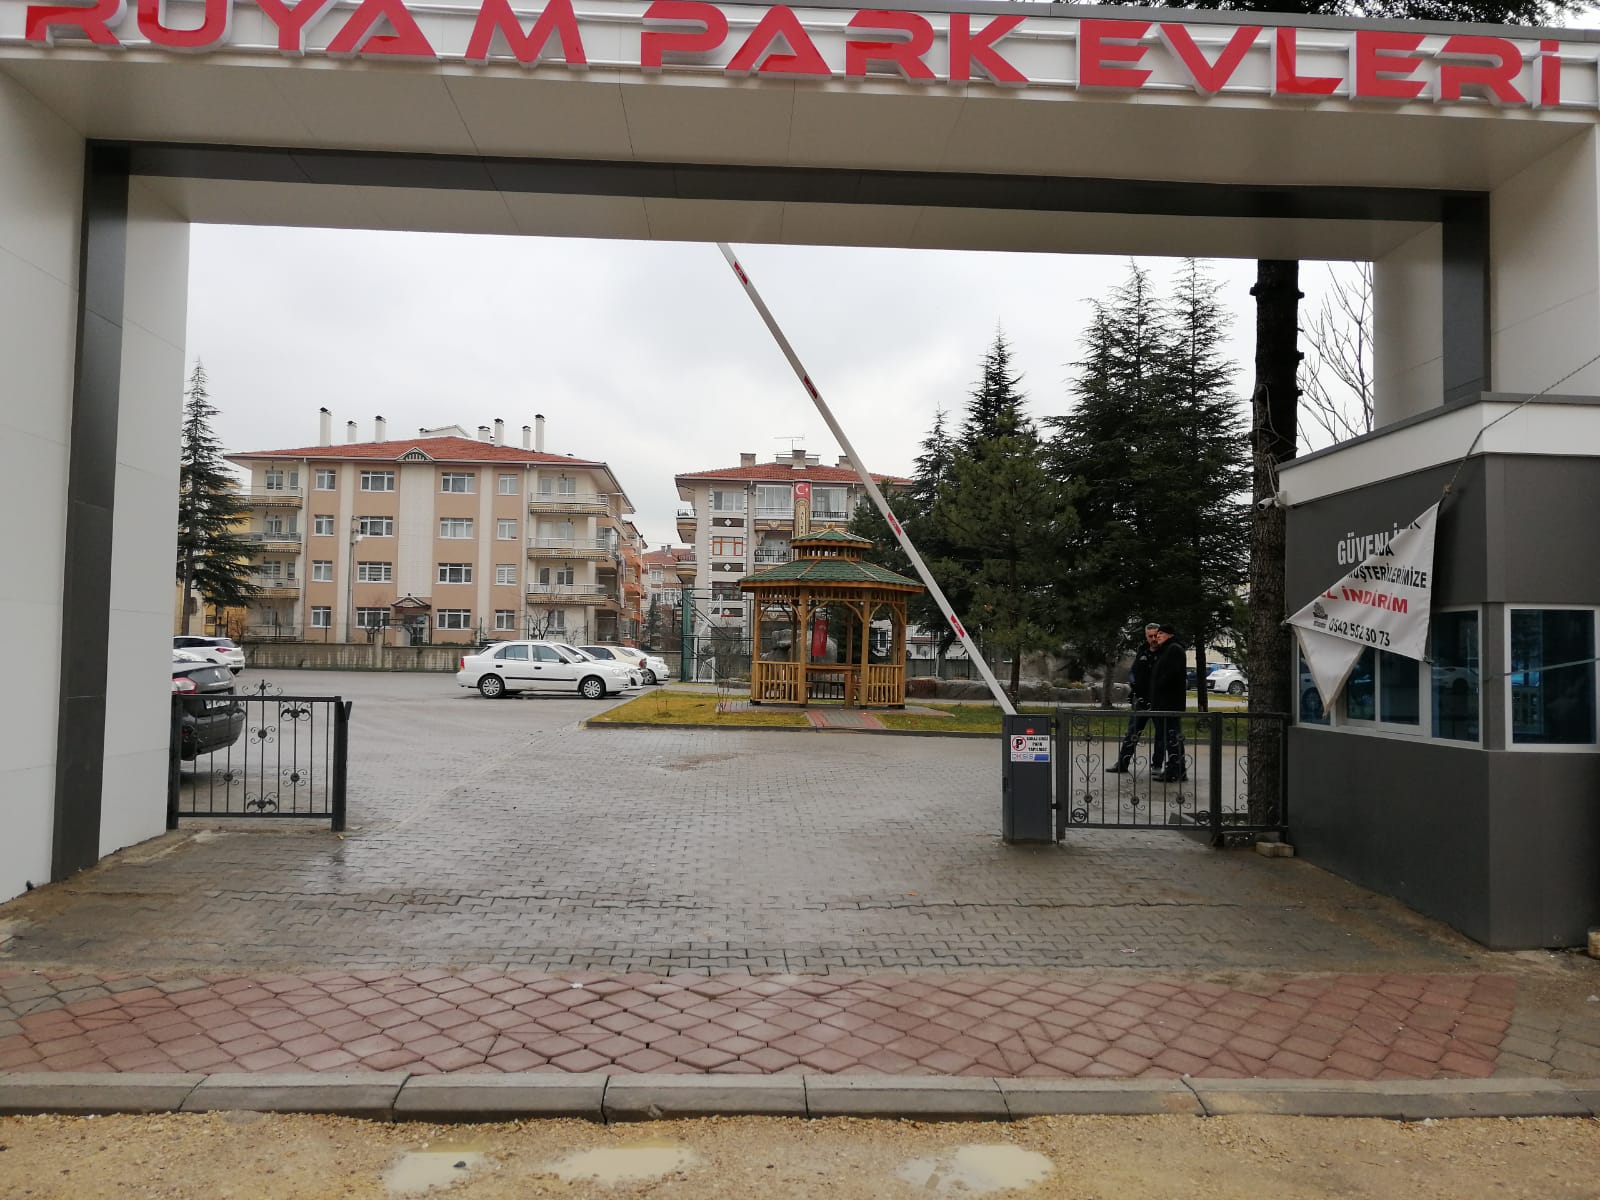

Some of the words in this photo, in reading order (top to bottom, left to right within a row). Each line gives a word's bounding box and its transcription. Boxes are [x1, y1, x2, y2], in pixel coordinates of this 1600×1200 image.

[641, 0, 1029, 83] PARK
[1341, 585, 1408, 614] İNDİRİM
[1328, 618, 1348, 635] 0542
[1365, 626, 1377, 643] 30
[1378, 630, 1390, 646] 73
